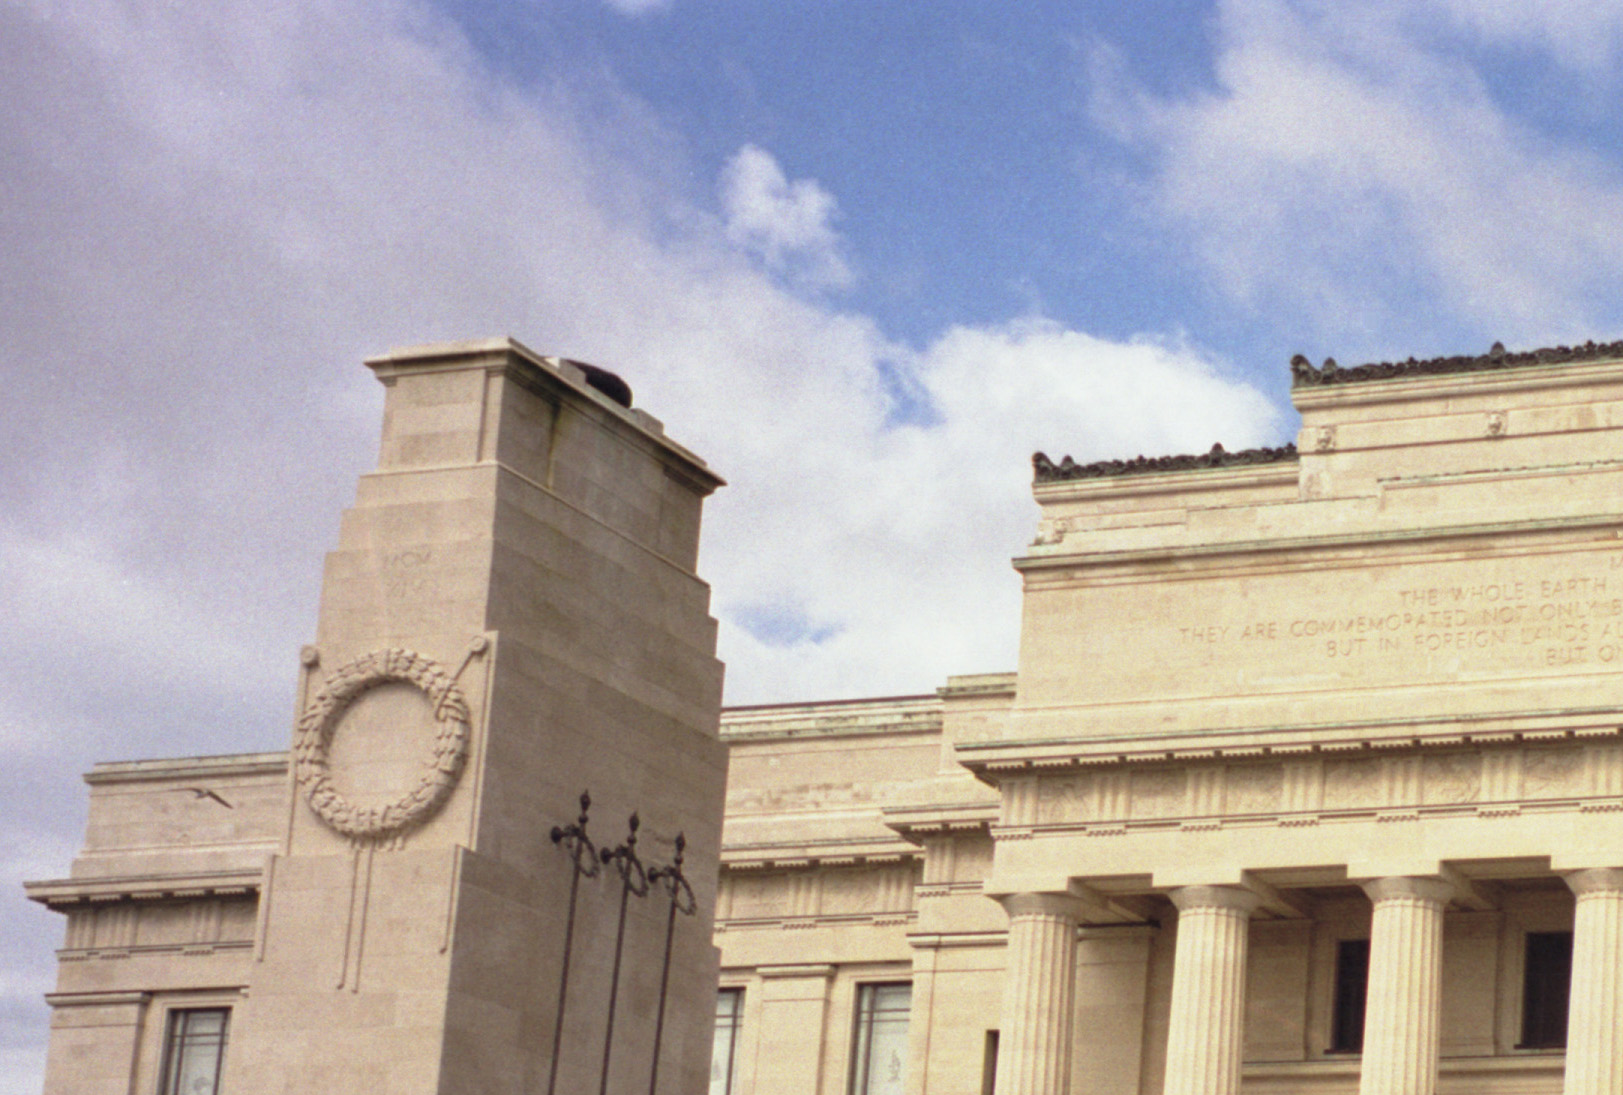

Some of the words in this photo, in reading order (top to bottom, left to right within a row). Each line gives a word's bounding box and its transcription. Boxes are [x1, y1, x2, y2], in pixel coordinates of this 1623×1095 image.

[1400, 588, 1438, 606] THE
[1452, 582, 1524, 601] WHOLE
[1541, 577, 1606, 598] EARTH
[1179, 626, 1230, 643] THEY
[1241, 622, 1277, 640] ARE
[1289, 609, 1468, 637] COMMEMORATED
[1482, 605, 1527, 624] NOT
[1539, 600, 1596, 619] ONLY
[1326, 638, 1367, 658] BUT
[1379, 637, 1399, 652] IN
[1414, 629, 1506, 651] FOREIGN
[1521, 624, 1589, 645] LANDS
[1546, 645, 1586, 666] BUT
